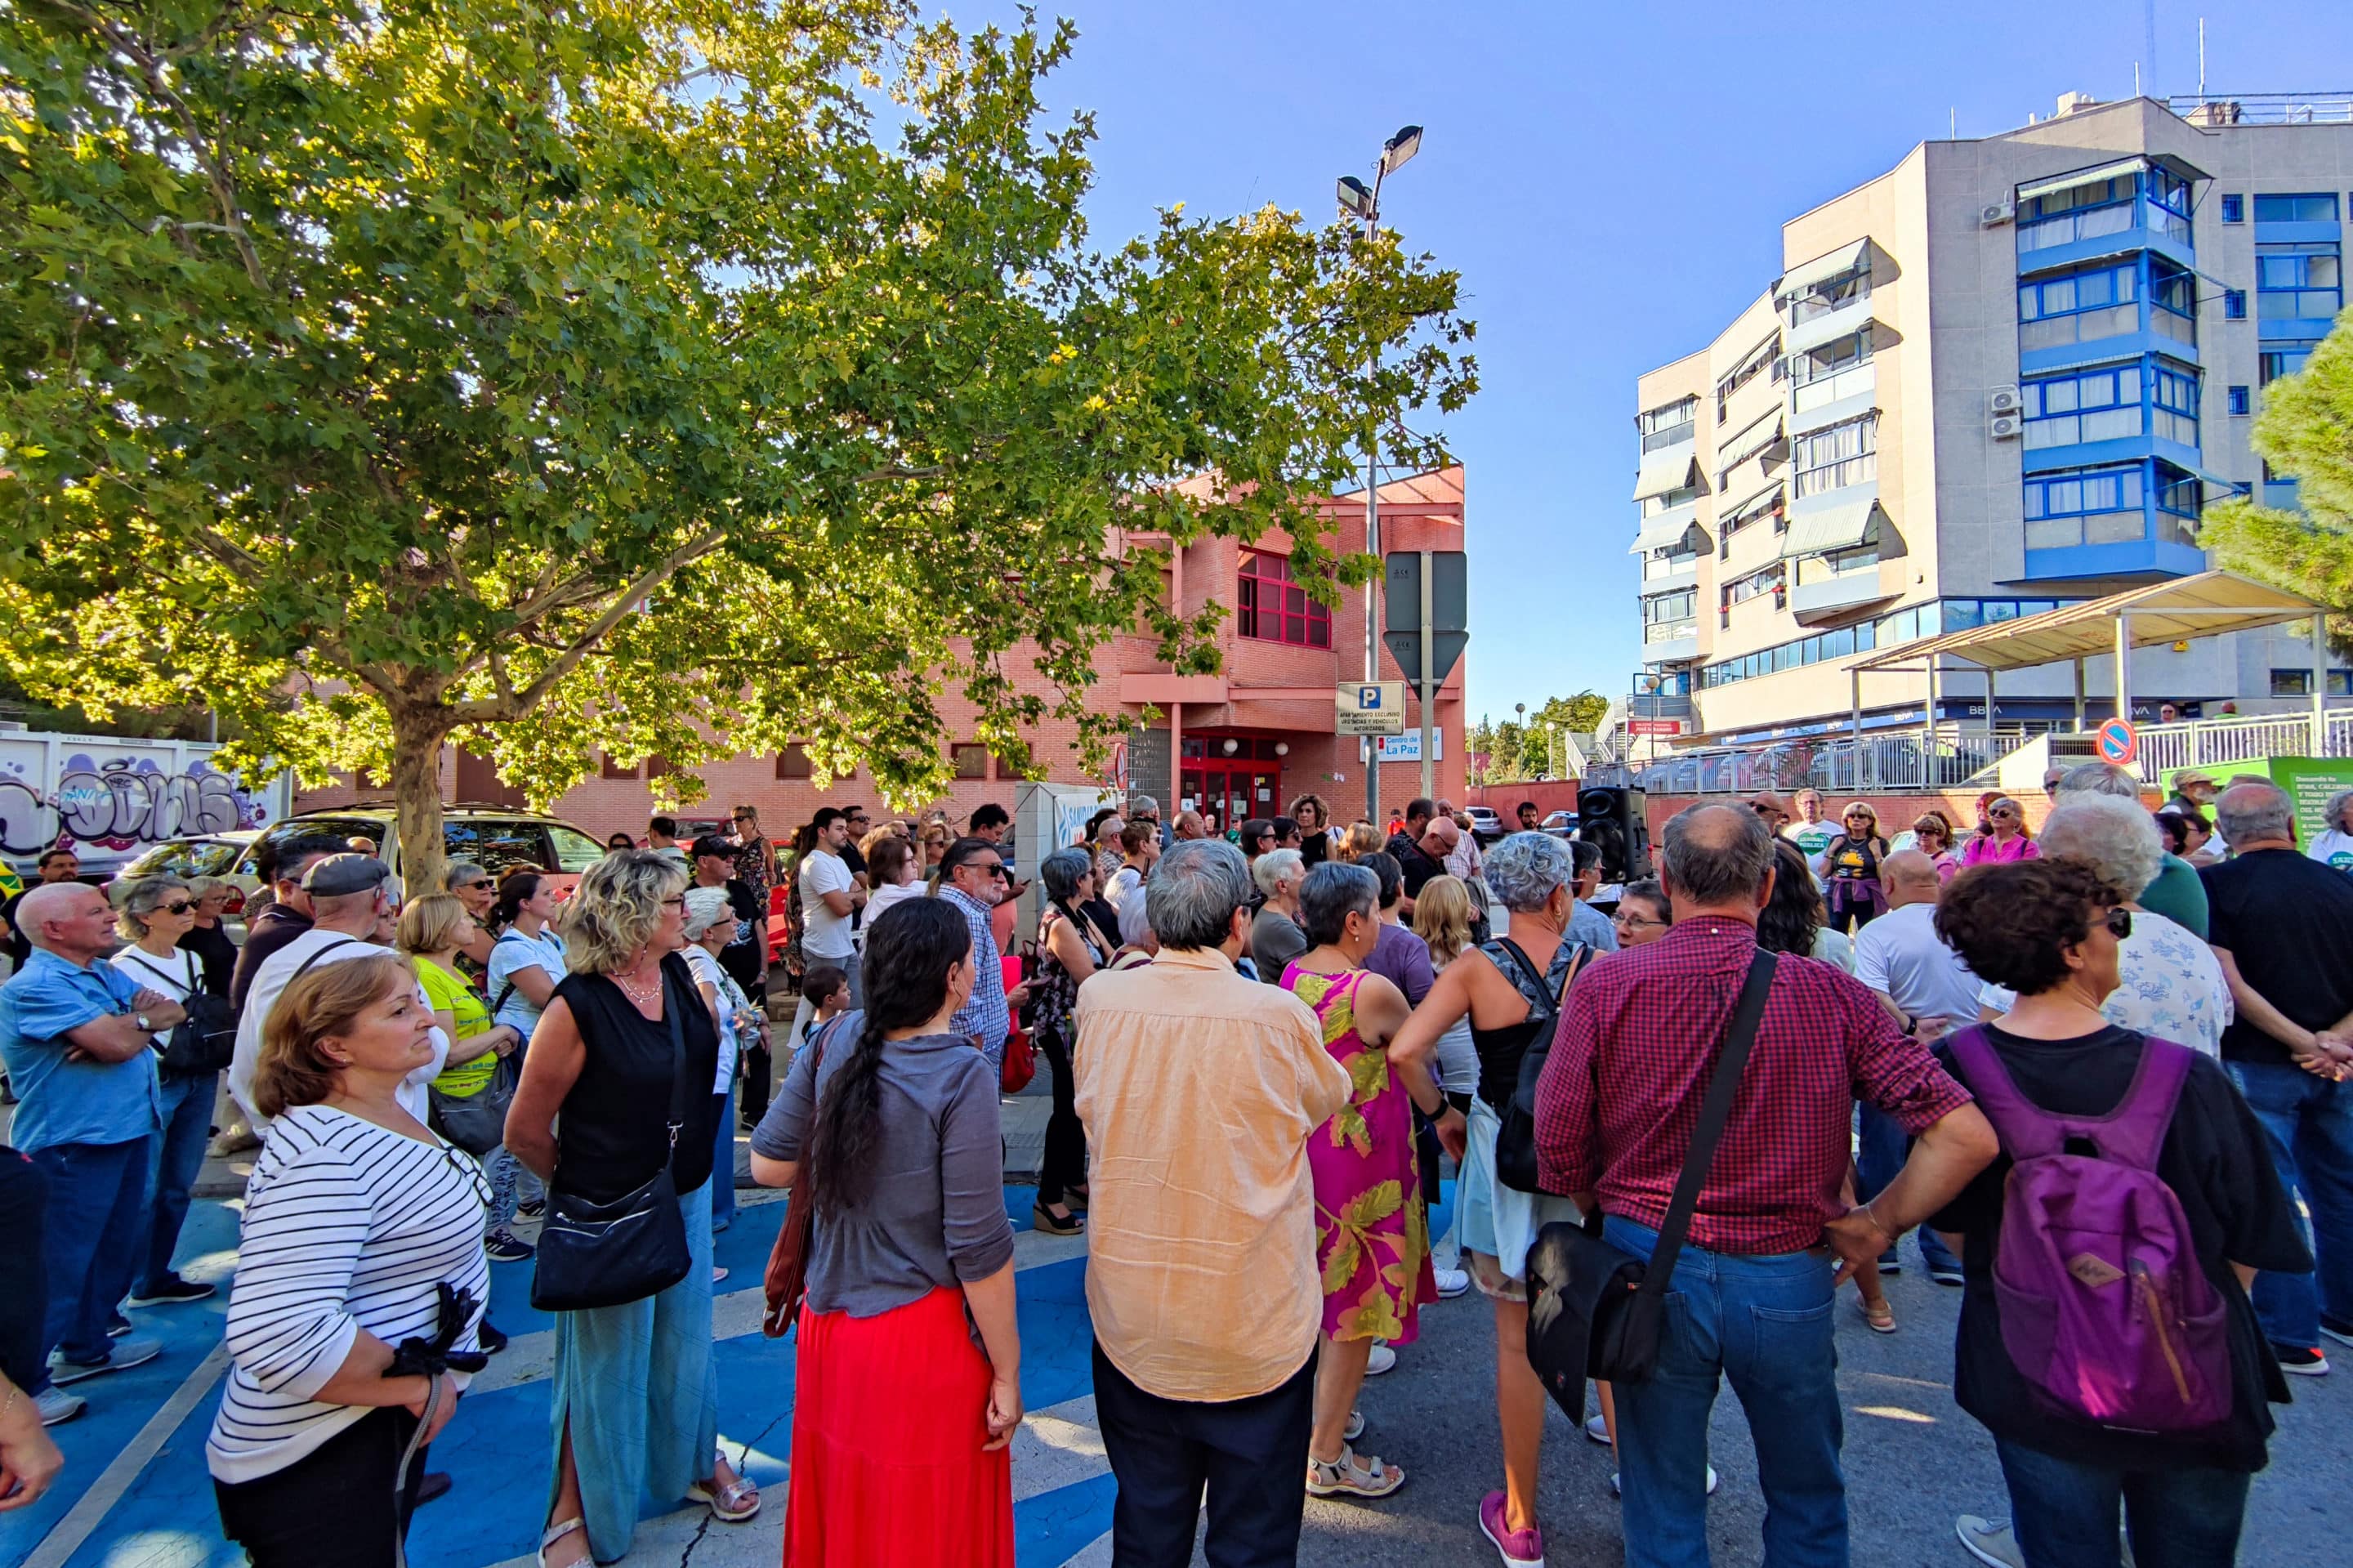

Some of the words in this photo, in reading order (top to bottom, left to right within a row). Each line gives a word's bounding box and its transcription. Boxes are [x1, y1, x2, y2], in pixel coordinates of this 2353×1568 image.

[1363, 688, 1377, 707] P
[1969, 705, 2003, 715] BBA
[1386, 745, 1398, 755] La
[1400, 744, 1418, 755] Paz
